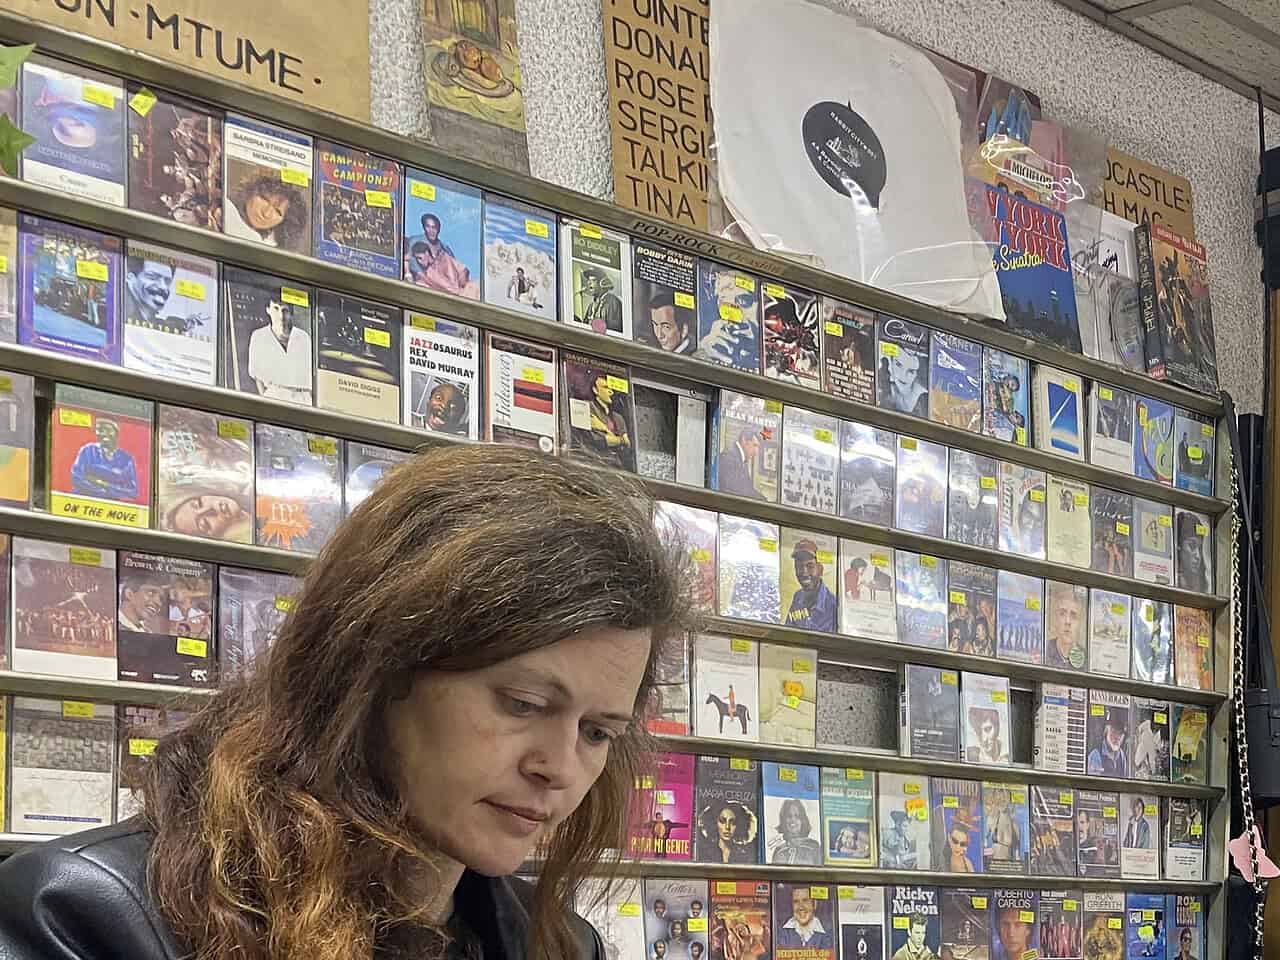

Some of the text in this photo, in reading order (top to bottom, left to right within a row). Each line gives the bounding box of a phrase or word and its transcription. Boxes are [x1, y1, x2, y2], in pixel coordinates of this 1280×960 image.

[614, 58, 697, 119] ROSE
[332, 169, 394, 188] CAMPIONS!
[626, 174, 697, 226] TINA
[632, 220, 724, 257] POP-ROCK
[636, 245, 667, 262] BOBBY
[409, 335, 473, 361] JAZZOSAURUS
[409, 346, 429, 360] REX
[409, 356, 475, 380] DAVID MURRAY
[62, 502, 138, 524] ON THE MOVE
[665, 838, 690, 855] GENTE
[895, 886, 935, 905] Ricky
[993, 888, 1035, 900] ROBERTO
[891, 899, 939, 916] Nelson
[997, 898, 1032, 910] CARLOS
